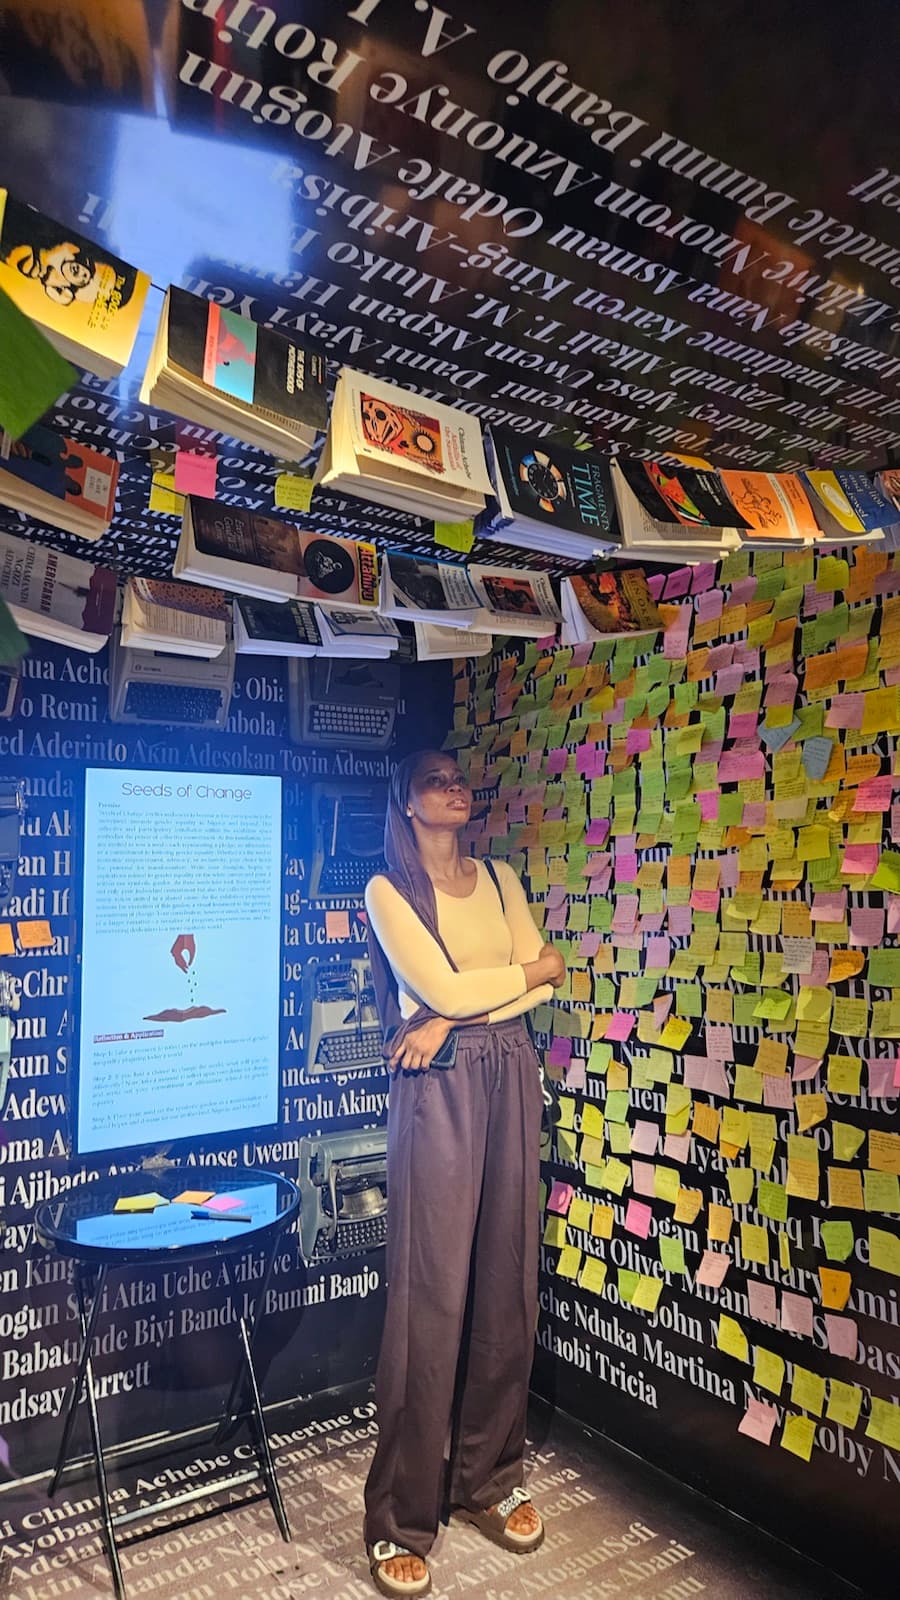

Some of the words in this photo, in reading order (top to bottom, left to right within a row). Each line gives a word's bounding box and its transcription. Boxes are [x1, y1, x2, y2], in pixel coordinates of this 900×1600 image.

[179, 50, 400, 172] Atogun
[487, 50, 649, 154] Banjo
[369, 72, 602, 197] Azuonye
[398, 158, 544, 238] Odafe
[629, 132, 799, 226] Bunmi
[594, 181, 769, 275] Nnorom
[326, 241, 467, 304] Aluko
[547, 224, 696, 297] Asmau
[263, 306, 383, 356] Ajayi
[348, 293, 488, 351] Akpan
[466, 292, 525, 328] M.
[523, 314, 566, 345] T.
[572, 287, 691, 344] Karen
[688, 282, 786, 333] Nana
[375, 342, 490, 391] Dami
[484, 341, 595, 389] Uwem
[558, 329, 677, 376] Alkali
[686, 331, 857, 396] Amadiume
[490, 380, 653, 433] Akinyemi
[596, 378, 690, 413] Ajose
[669, 366, 785, 412] Zaynab
[646, 424, 712, 453] Tolu
[679, 404, 786, 441] Audrey
[571, 463, 600, 527] TIME
[358, 545, 376, 602] Attahiru
[40, 693, 97, 722] Remi
[29, 731, 128, 762] Aderinto
[184, 742, 278, 773] Adesokan
[279, 749, 328, 777] Toyin
[121, 782, 173, 797] Seeds
[176, 784, 193, 798] of
[195, 785, 253, 802] Change
[294, 1093, 334, 1122] Tolu
[113, 1281, 156, 1310] Atta
[163, 1264, 212, 1299] Uche
[135, 1310, 174, 1348] Biyi
[265, 1275, 326, 1316] Bunmi
[330, 1265, 379, 1300] Banjo
[574, 1299, 638, 1358] Nduka
[642, 1331, 737, 1406] Martina
[594, 1350, 659, 1410] Tricia
[136, 1453, 231, 1496] Achebe
[233, 1414, 353, 1460] Ctherine
[216, 1554, 288, 1588] Tolu
[617, 1538, 696, 1583] Abani
